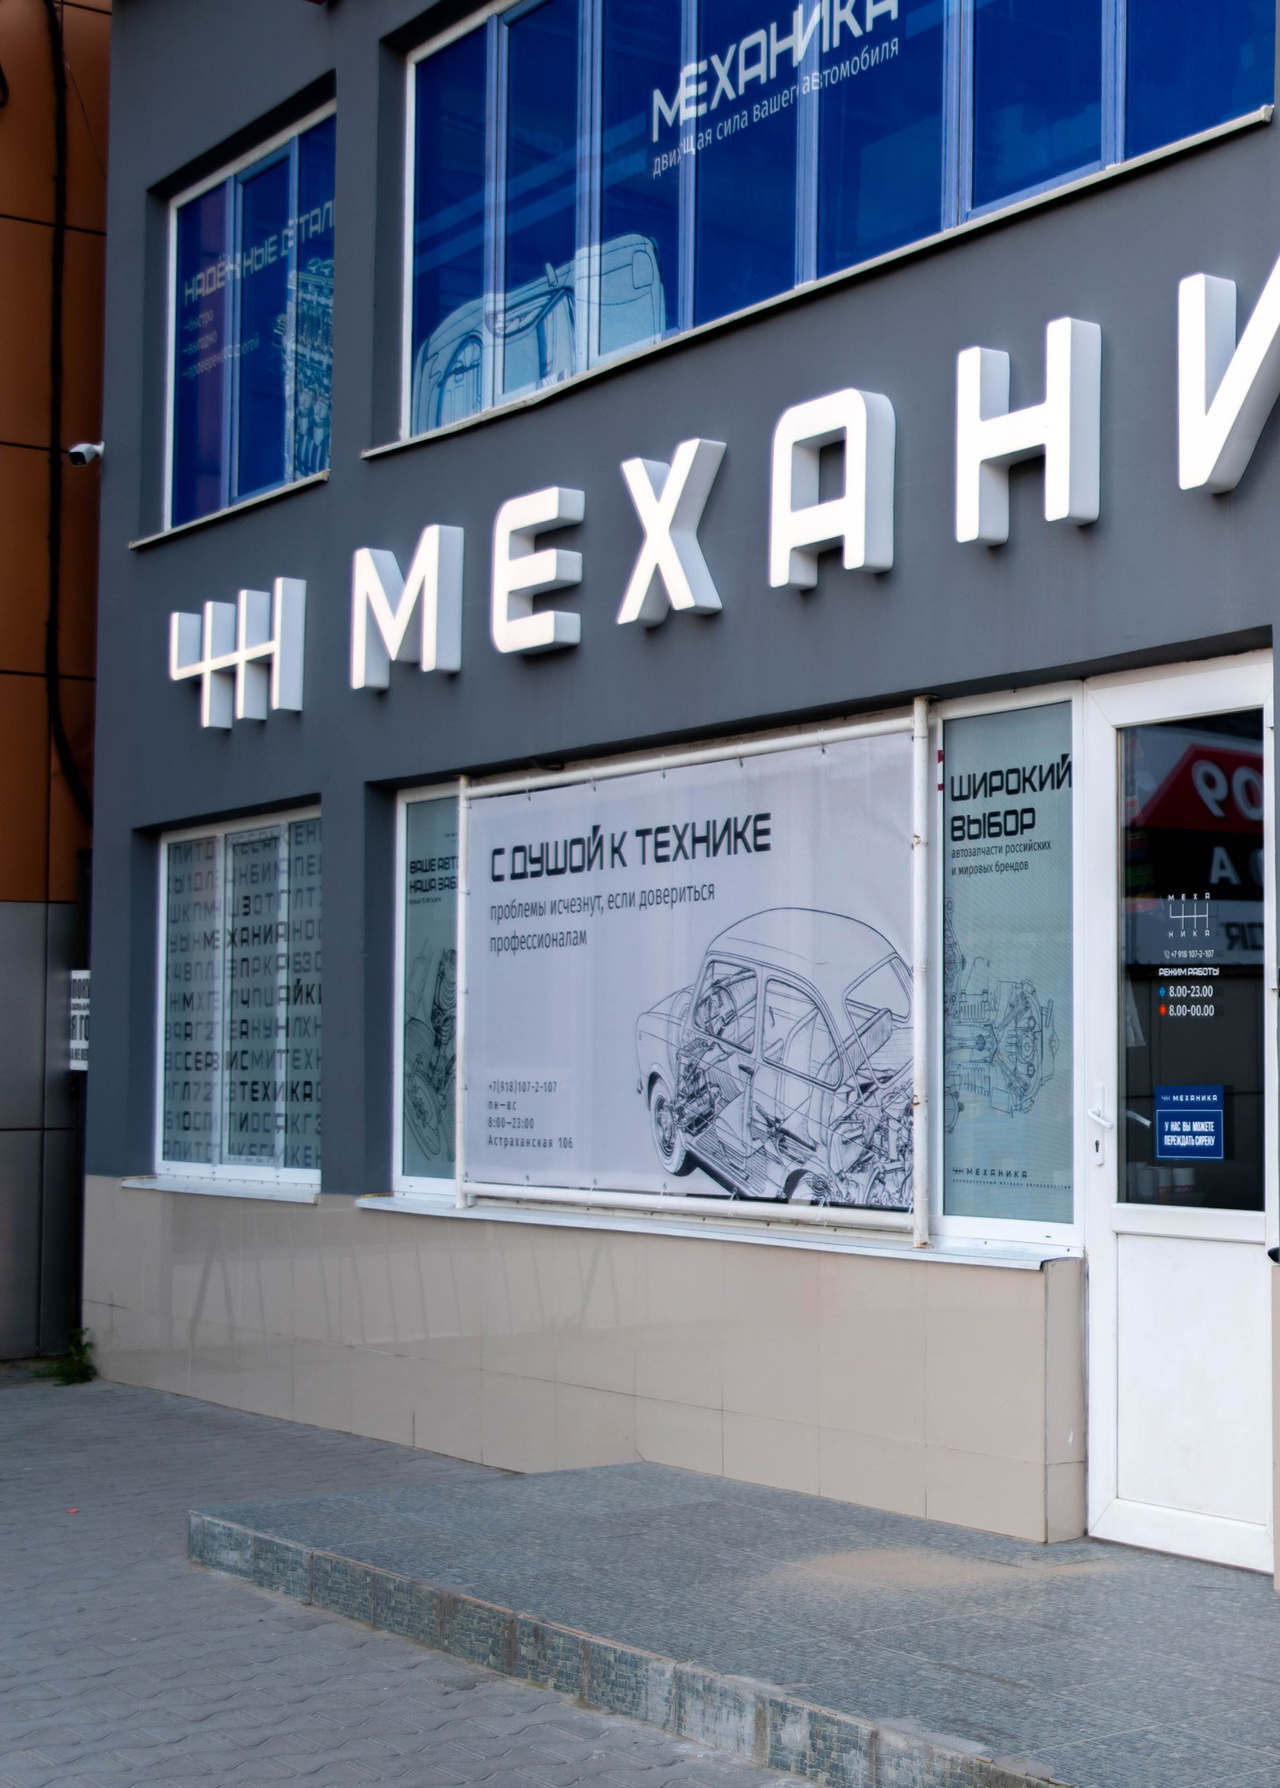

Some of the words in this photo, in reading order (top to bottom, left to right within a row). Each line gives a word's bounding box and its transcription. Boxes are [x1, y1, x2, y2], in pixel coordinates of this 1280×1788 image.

[653, 0, 899, 143] МЕХАНИКА
[652, 128, 712, 180] двищая
[716, 109, 749, 142] сила
[753, 84, 799, 124] вашег
[802, 36, 900, 95] автомобиля
[950, 753, 1073, 802] ШИРОКИЙ
[951, 807, 1036, 842] ВЫБОР
[491, 847, 506, 882] С
[510, 824, 605, 881] ДУШОЙ
[610, 830, 628, 869] К
[635, 812, 772, 865] ТЕХНИКЕ
[951, 844, 1004, 859] автозапчасти
[1005, 839, 1052, 857] российских
[951, 867, 957, 876] и
[958, 863, 994, 878] мировых
[995, 860, 1029, 875] брендов
[438, 875, 459, 892] ЗАБ
[490, 898, 547, 925] проблемы
[550, 893, 605, 919] исчезнут,
[608, 890, 636, 911] если
[639, 882, 716, 911] довериться
[490, 928, 588, 957] профессионалам
[1178, 950, 1188, 958] 918
[1188, 949, 1215, 958] 107-2-107
[1158, 967, 1187, 977] РЕЖИМ
[1187, 966, 1220, 977] РАБОТЫ
[1168, 985, 1214, 998] 8.00-23.00
[1168, 1004, 1215, 1017] 8.00-00.00
[488, 1079, 558, 1094] +7(918)107-2-107
[1172, 1094, 1218, 1102] МЕХАНИКА
[1164, 1121, 1170, 1131] У
[1170, 1121, 1181, 1132] НАС
[1182, 1121, 1191, 1132] ВЫ
[1192, 1121, 1215, 1132] МОЖЕТЕ
[488, 1134, 554, 1149] Астраханская
[558, 1137, 574, 1149] 106
[1164, 1135, 1195, 1147] ПЕРЕЖДАТЬ
[1195, 1135, 1216, 1146] СИРЕНУ
[966, 1167, 1028, 1179] МЕХАНИКА
